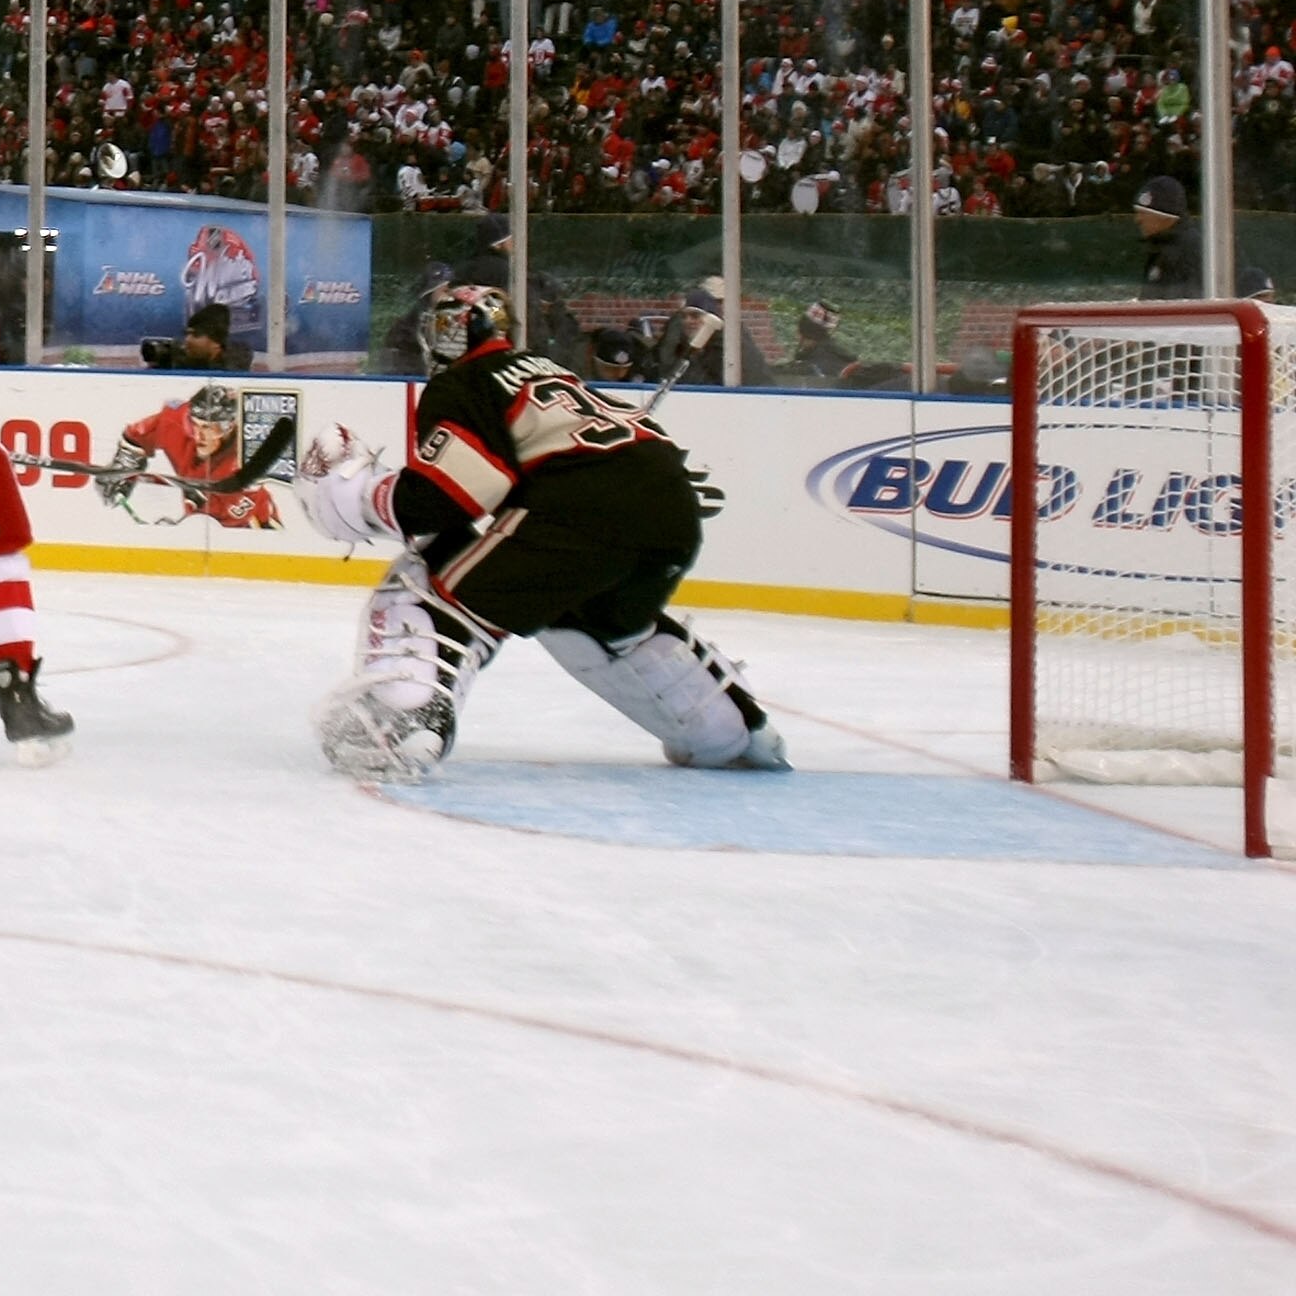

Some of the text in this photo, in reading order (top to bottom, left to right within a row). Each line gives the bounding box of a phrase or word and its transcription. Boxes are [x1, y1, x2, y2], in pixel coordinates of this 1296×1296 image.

[116, 271, 160, 284] NHL
[119, 283, 166, 295] NBC
[317, 281, 358, 292] NHL
[318, 292, 361, 304] NBC
[0, 419, 90, 488] 09
[847, 455, 1083, 522] BUD
